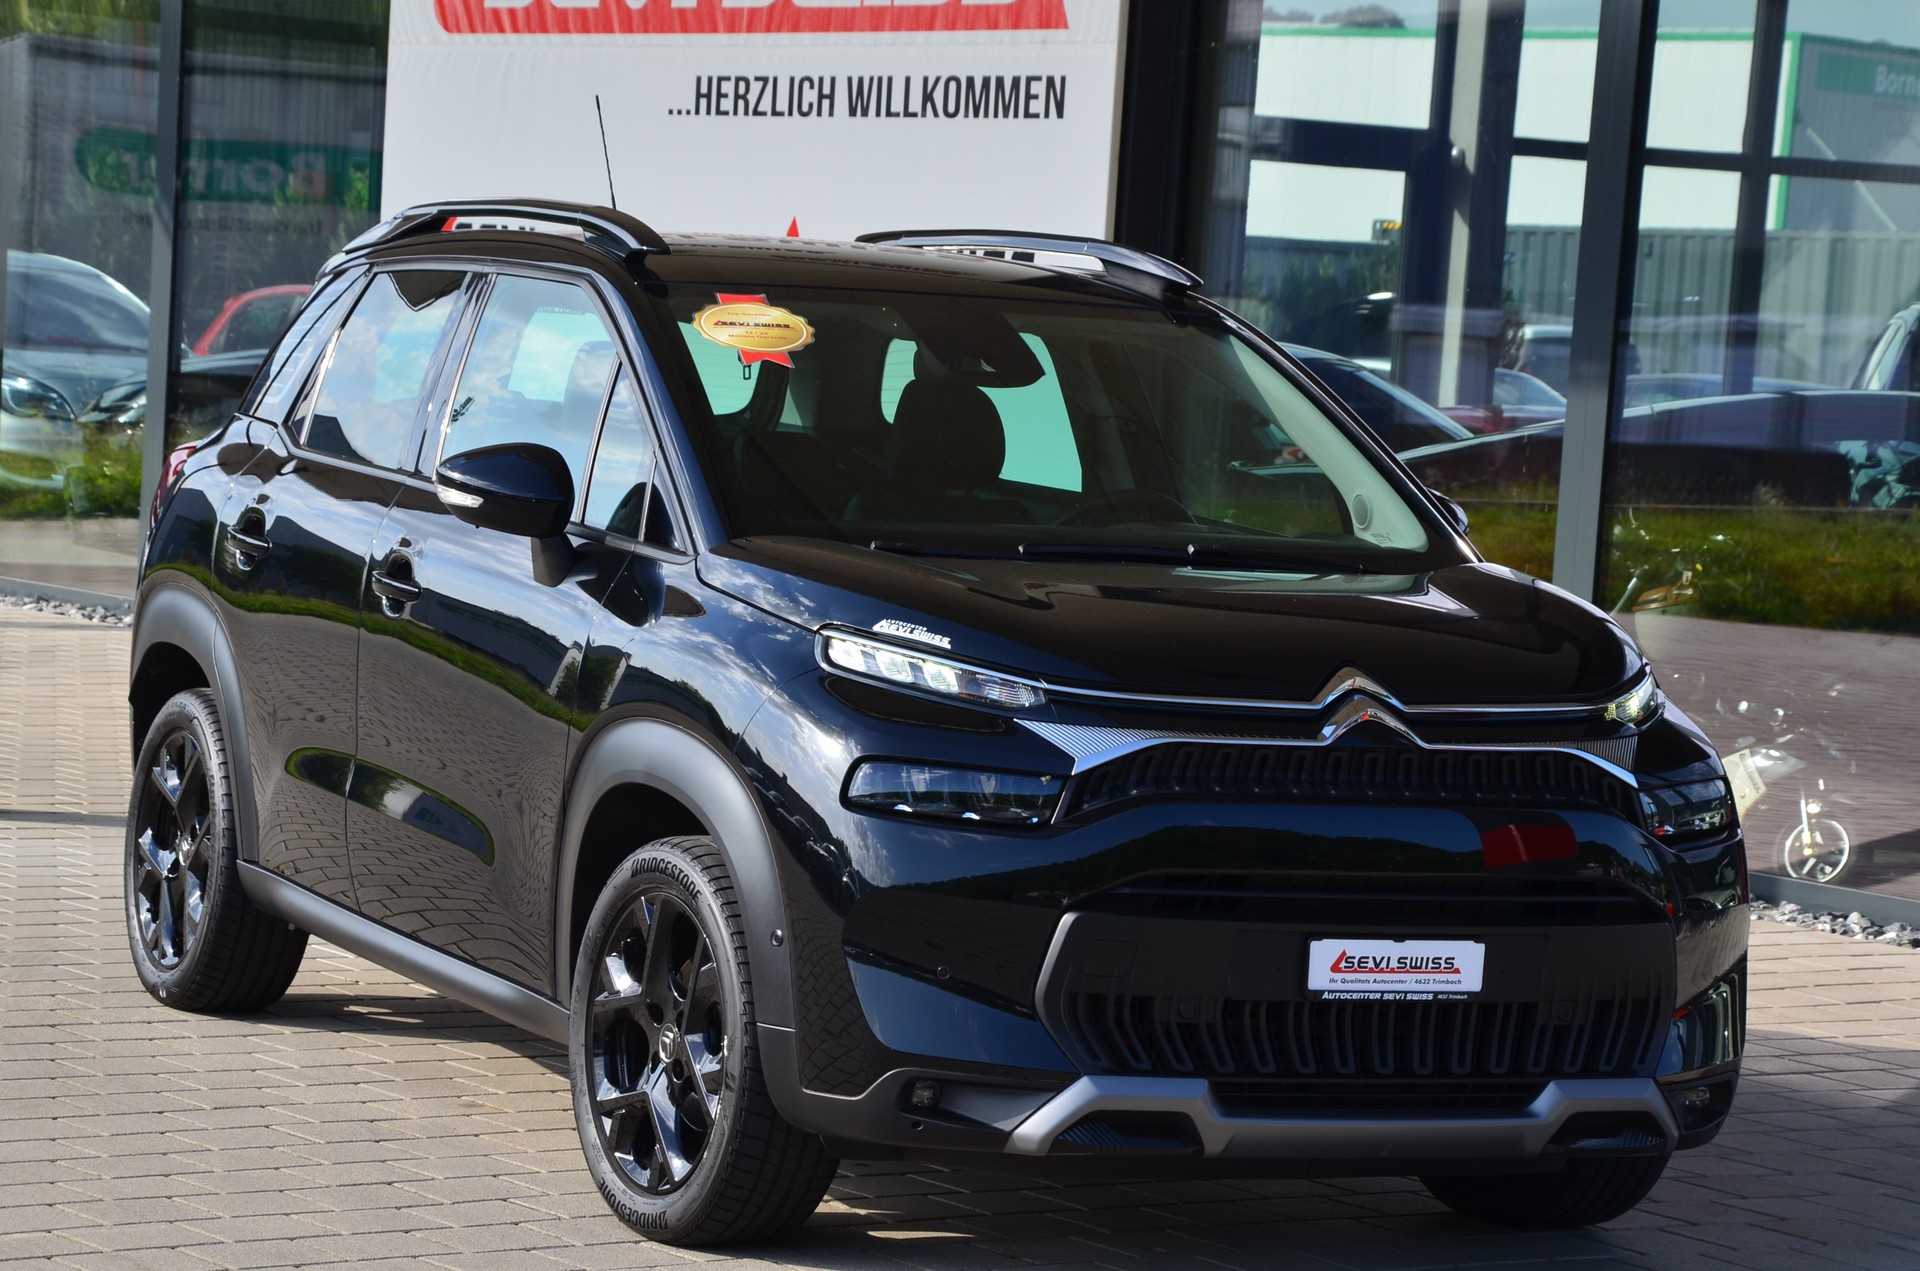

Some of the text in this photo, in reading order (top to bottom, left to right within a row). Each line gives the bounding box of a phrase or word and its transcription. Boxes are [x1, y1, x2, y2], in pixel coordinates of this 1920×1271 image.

[847, 75, 1067, 120] WILLKOMMEN
[886, 618, 928, 632] AUTOCENTER
[630, 856, 703, 906] BRIDGESTONE
[1322, 990, 1381, 1000] AUTOCENTER
[1382, 992, 1405, 1000] SEVI
[598, 1176, 668, 1231] BRIDGESTONE
